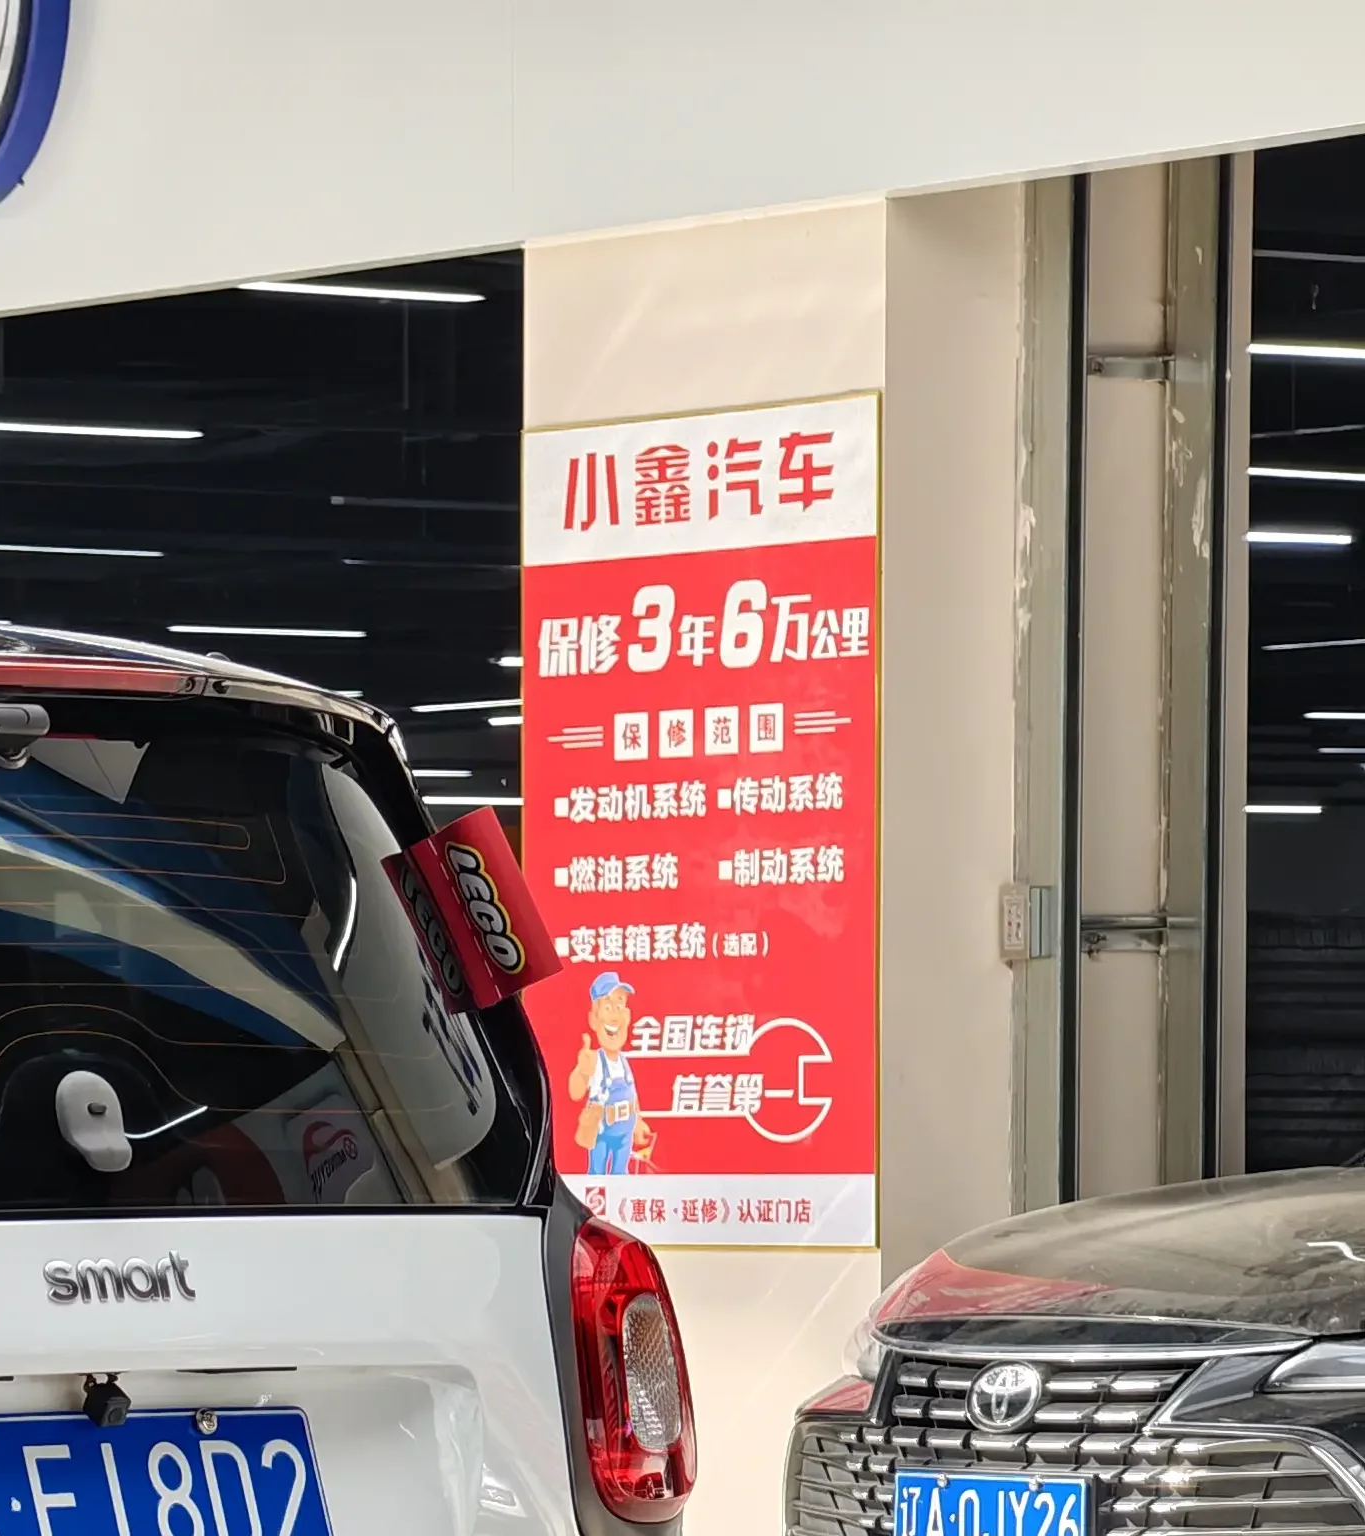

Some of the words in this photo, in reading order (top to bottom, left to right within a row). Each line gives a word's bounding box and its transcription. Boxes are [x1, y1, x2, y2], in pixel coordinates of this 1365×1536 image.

[563, 431, 835, 532] 小鑫汽车
[537, 578, 870, 678] 保修3年6万公里
[621, 712, 777, 754] 保修范围
[569, 780, 707, 823] 发动机系统
[733, 772, 843, 814] 传动系统
[569, 853, 679, 894] 燃油系统
[733, 845, 844, 887] 制动系统
[447, 845, 522, 972] LEGO
[630, 1013, 756, 1053] 全国连锁
[671, 1073, 795, 1115] 信誉第一
[42, 1249, 197, 1304] smart
